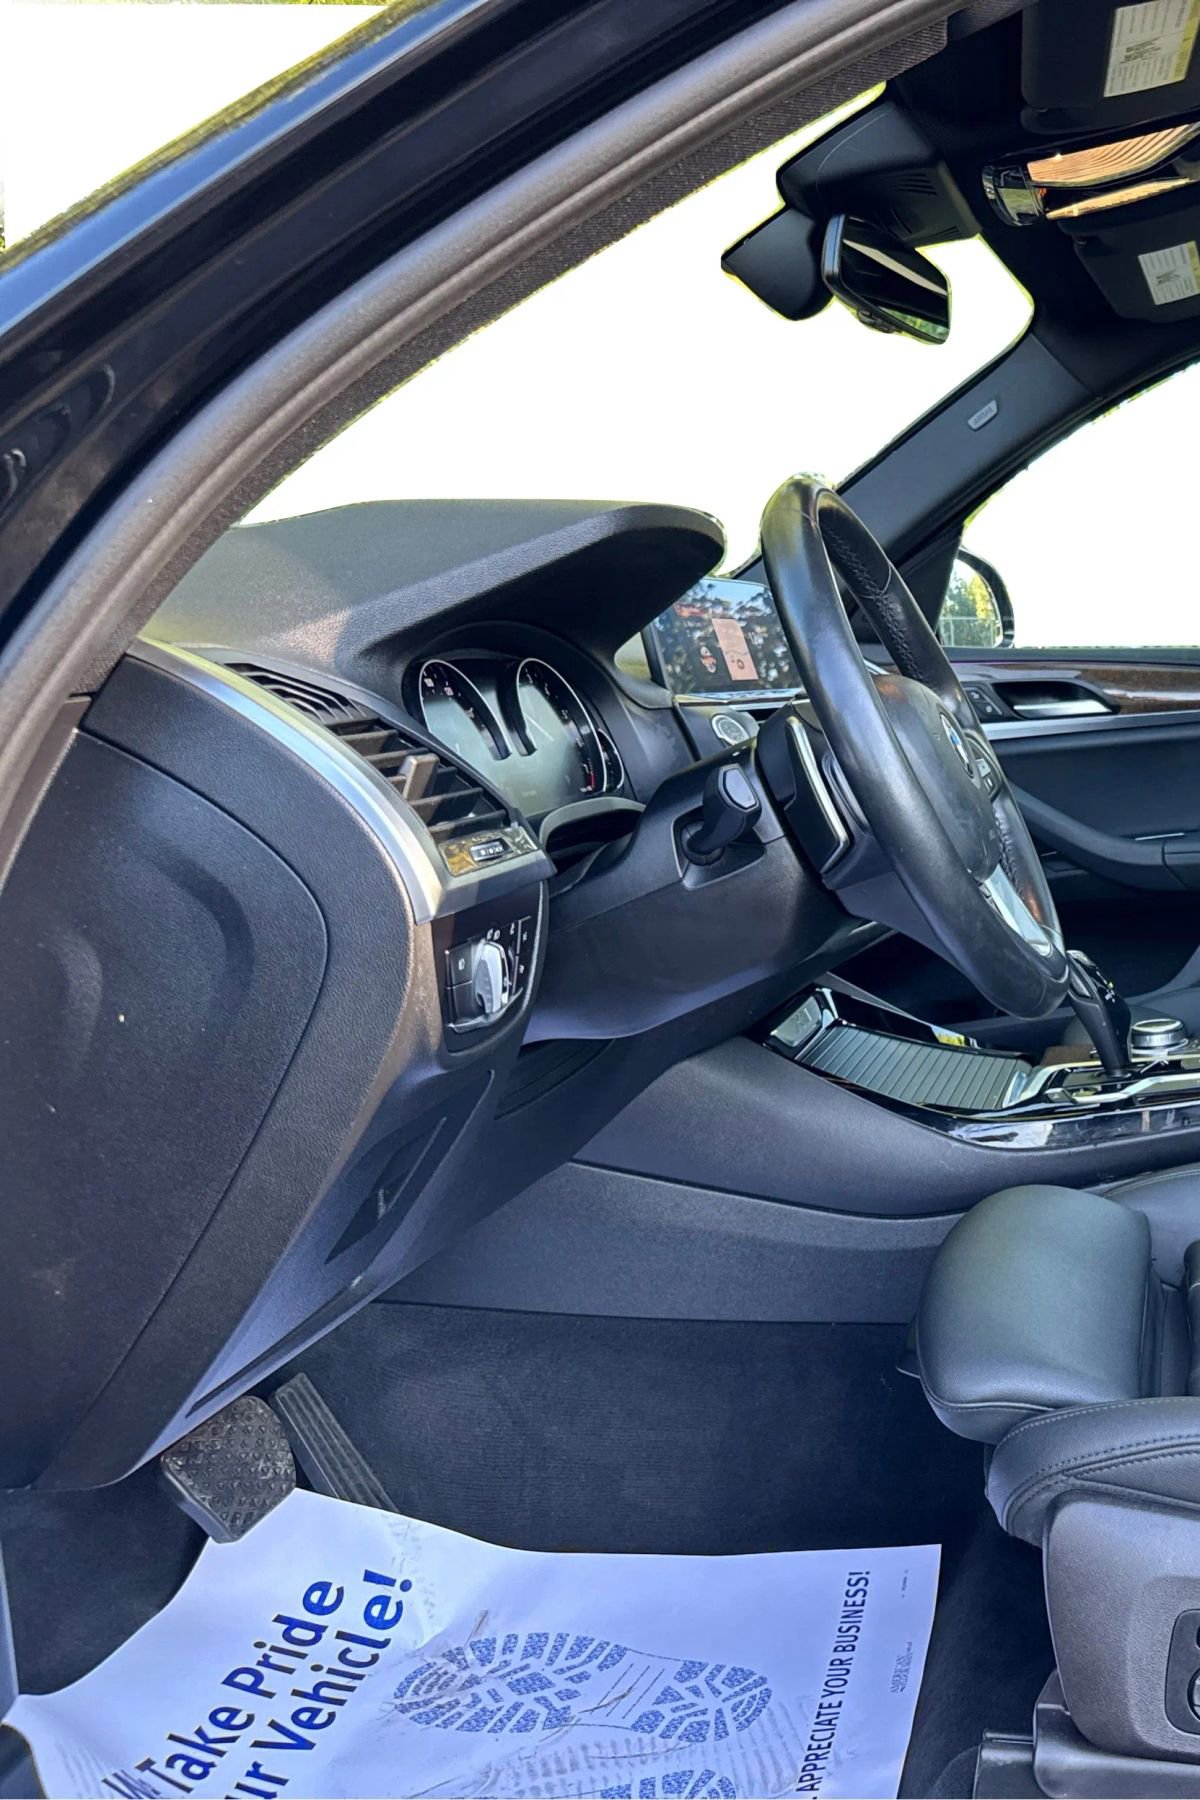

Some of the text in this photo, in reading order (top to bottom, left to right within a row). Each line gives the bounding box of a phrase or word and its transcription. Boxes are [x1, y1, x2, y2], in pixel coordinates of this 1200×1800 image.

[135, 1706, 255, 1794] Take
[221, 1581, 345, 1699] Pride
[250, 1569, 413, 1750] Vehicle!
[796, 1571, 871, 1792] APPRECIATE YOUR BUSINESS!
